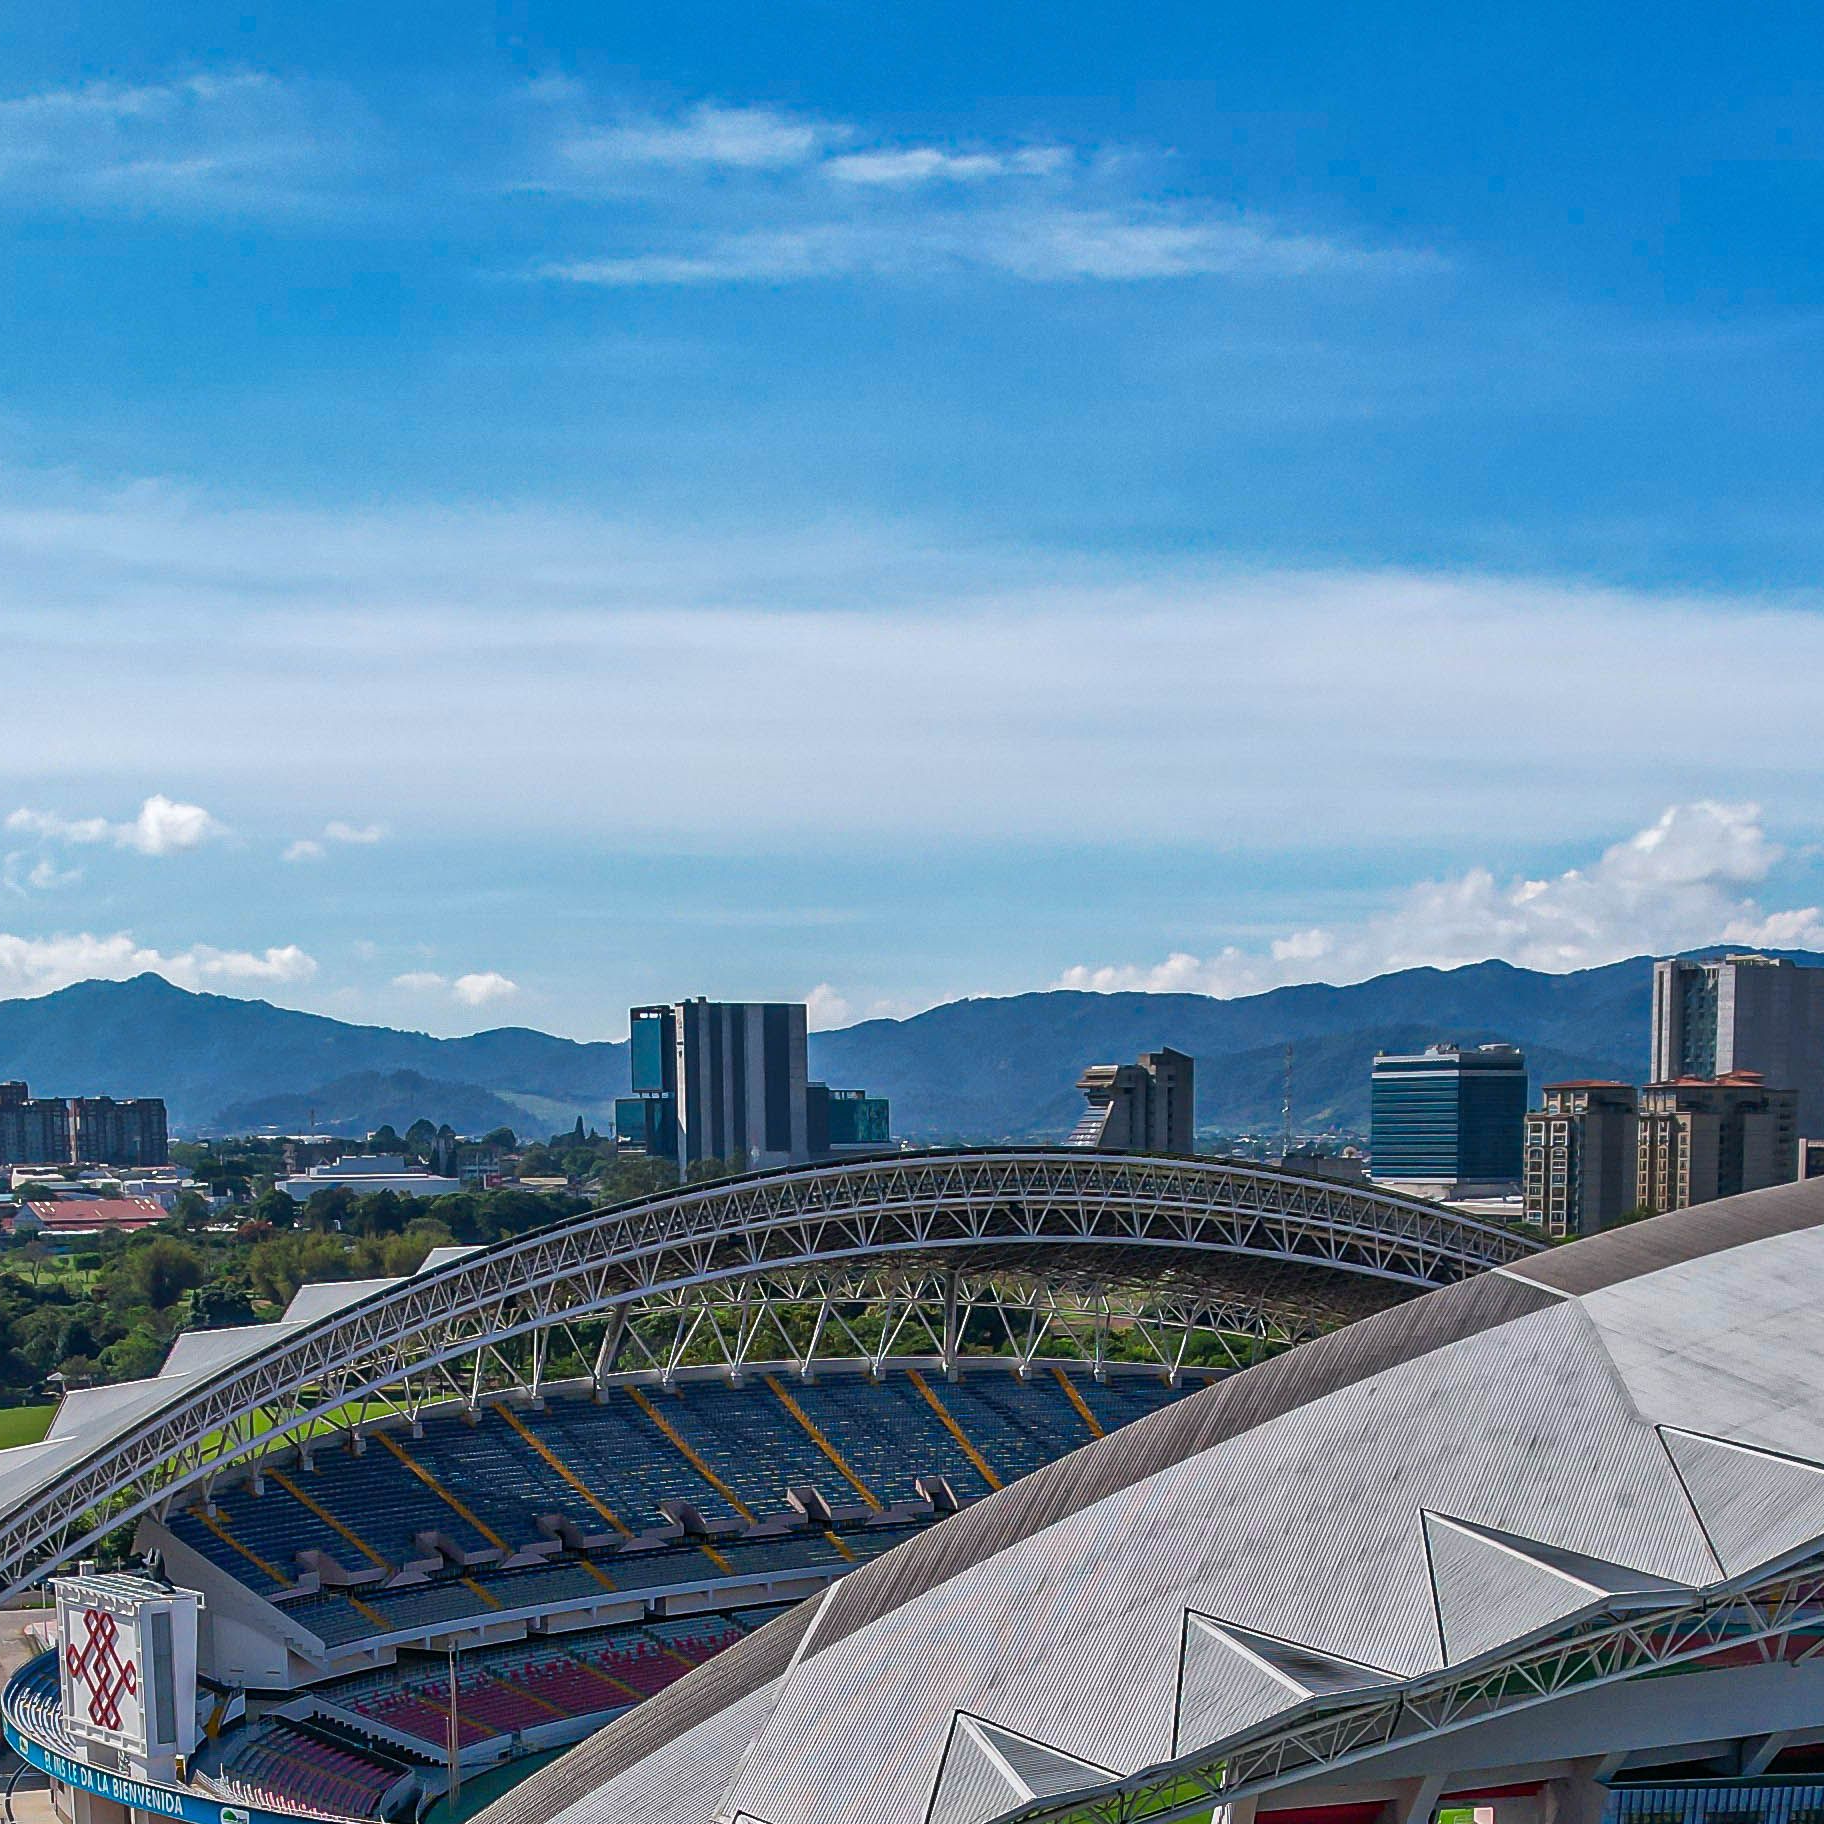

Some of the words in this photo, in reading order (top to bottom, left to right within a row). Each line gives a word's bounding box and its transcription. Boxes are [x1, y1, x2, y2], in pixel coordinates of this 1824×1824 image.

[68, 1761, 77, 1783] LE
[80, 1766, 93, 1789] DA
[97, 1772, 109, 1795] LA
[112, 1778, 184, 1816] BIENVENIDA
